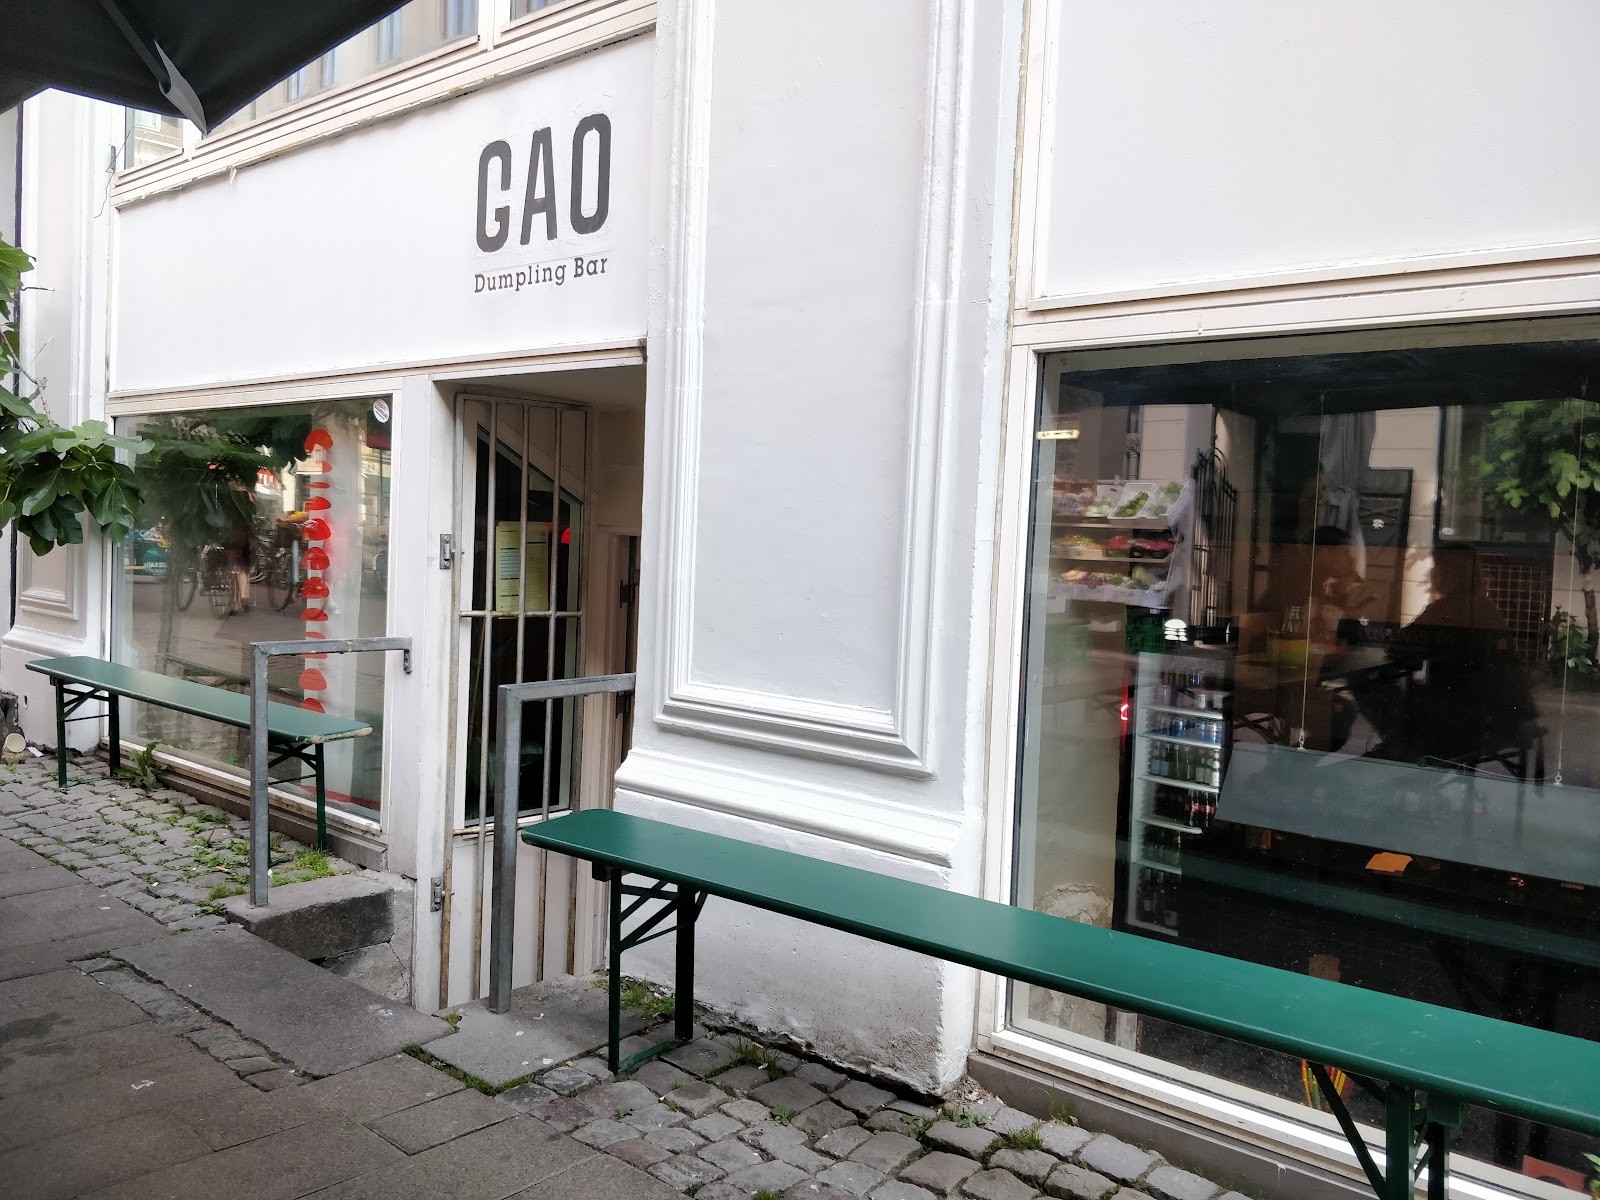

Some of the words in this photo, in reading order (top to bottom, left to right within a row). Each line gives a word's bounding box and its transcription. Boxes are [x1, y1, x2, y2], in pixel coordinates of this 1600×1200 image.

[476, 113, 612, 253] GAO
[474, 264, 567, 294] Dumpling
[573, 257, 608, 279] Bar
